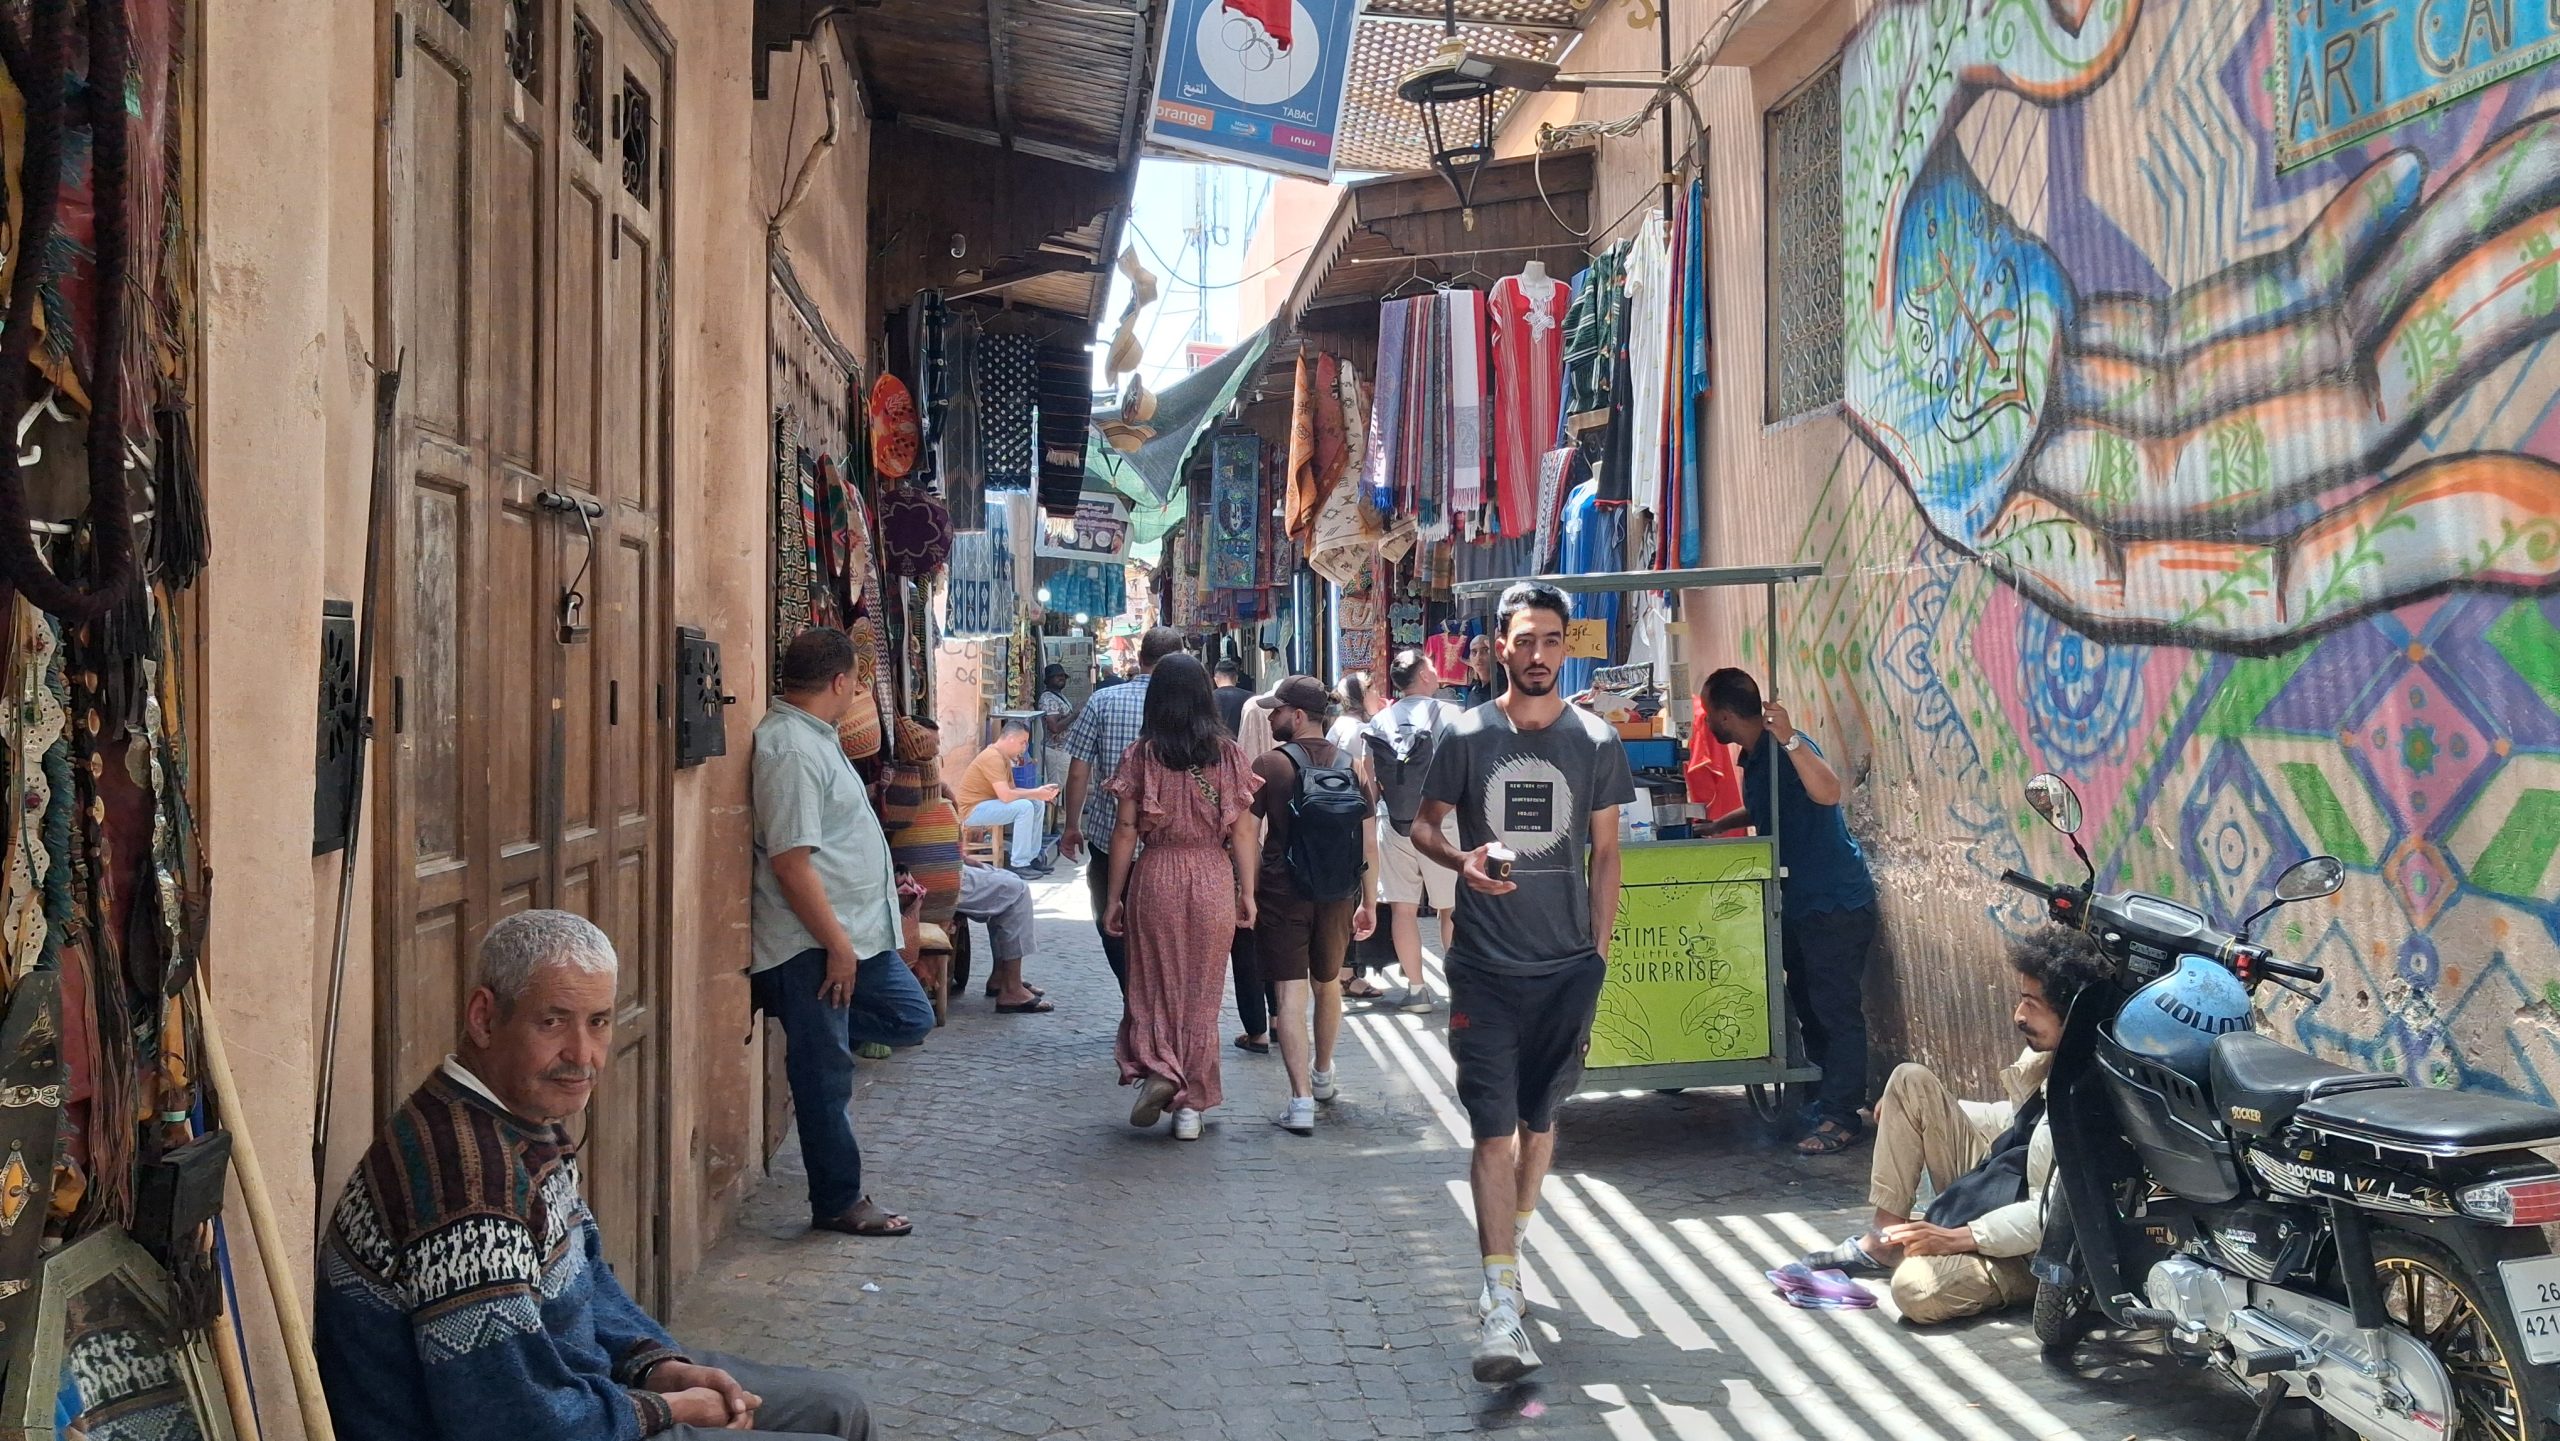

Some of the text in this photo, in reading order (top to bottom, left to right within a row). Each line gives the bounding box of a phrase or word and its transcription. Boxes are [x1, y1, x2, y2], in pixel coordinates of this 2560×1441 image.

[2289, 9, 2396, 141] ART
[1156, 105, 1208, 126] orange
[1282, 106, 1315, 122] TABAC
[1622, 960, 1718, 984] SURPRISE
[2286, 1162, 2336, 1185] DOCKER
[2145, 1226, 2165, 1236] FIFTY
[2537, 1282, 2560, 1303] 26
[2526, 1313, 2560, 1337] 421
